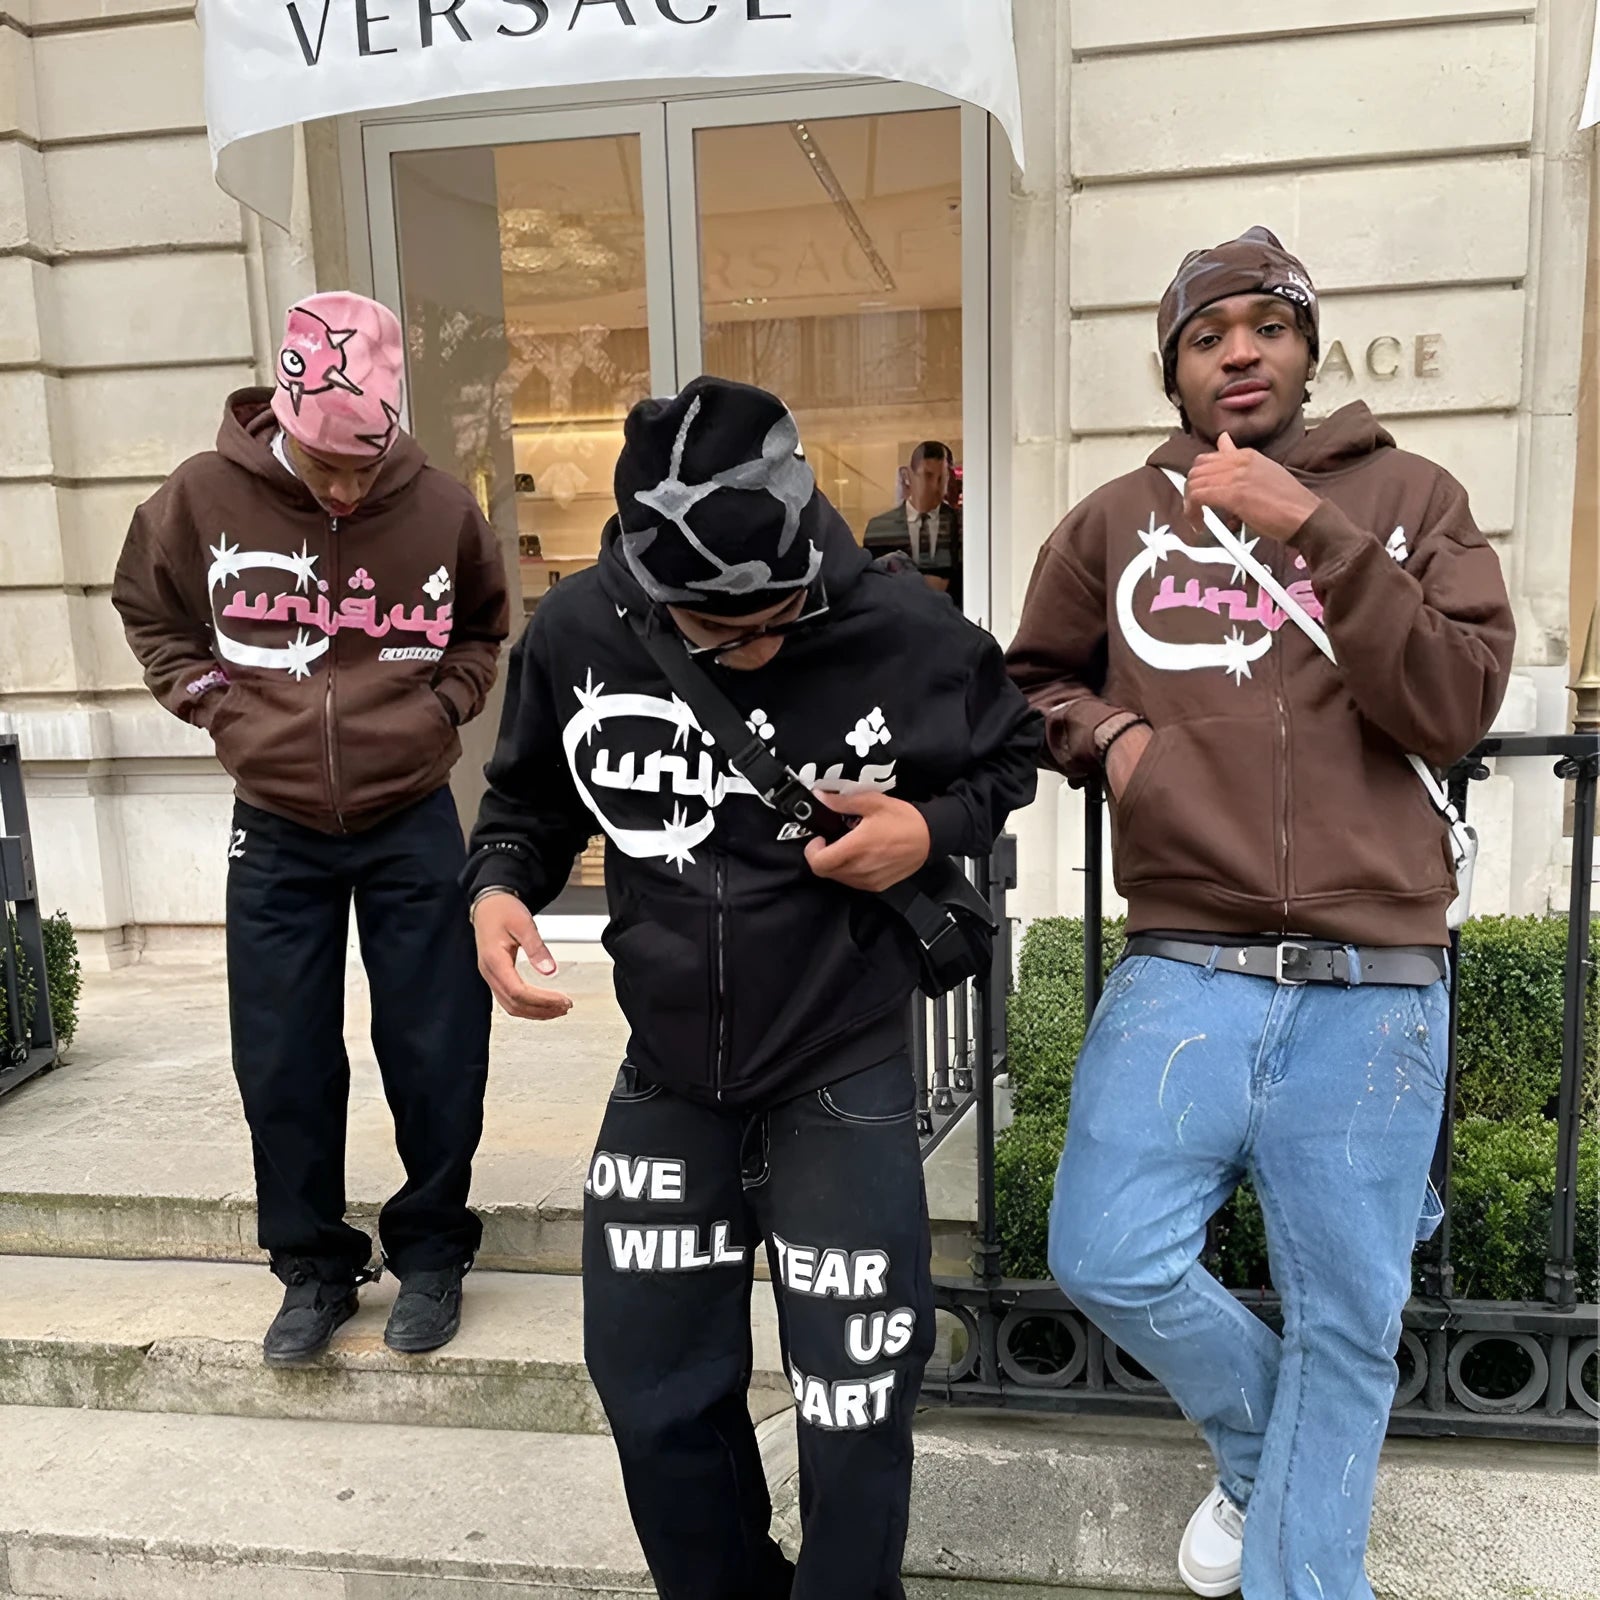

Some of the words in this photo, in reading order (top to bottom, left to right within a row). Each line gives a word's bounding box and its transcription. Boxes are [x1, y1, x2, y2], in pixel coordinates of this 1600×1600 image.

[585, 1151, 686, 1202] OVE
[604, 1220, 745, 1272] WILL
[845, 1307, 915, 1364] US
